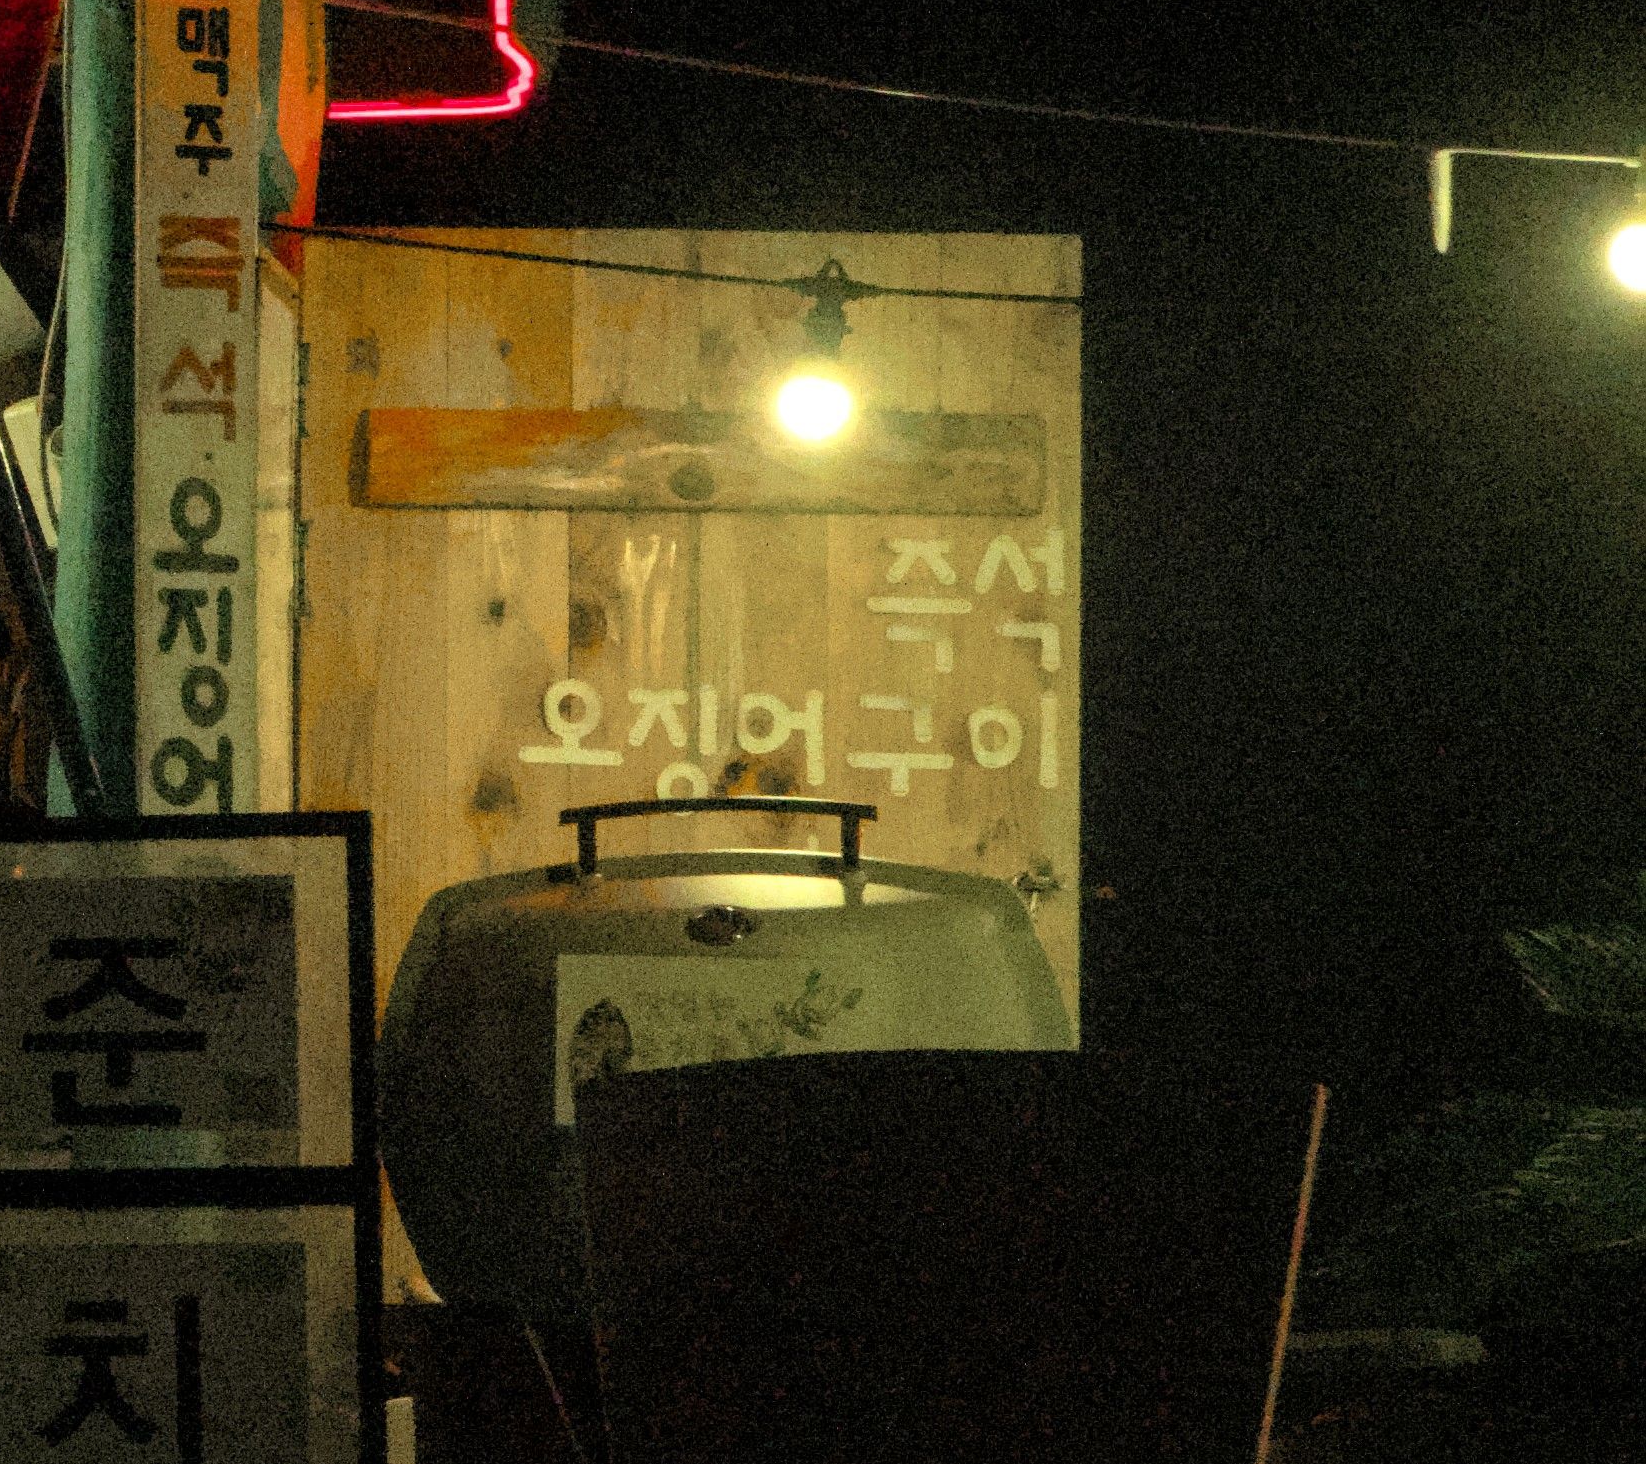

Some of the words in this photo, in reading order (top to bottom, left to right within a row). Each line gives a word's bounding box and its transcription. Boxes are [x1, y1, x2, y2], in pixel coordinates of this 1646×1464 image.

[158, 213, 244, 442] 즉석
[153, 478, 241, 814] 오징어
[866, 528, 1066, 675] 즉석
